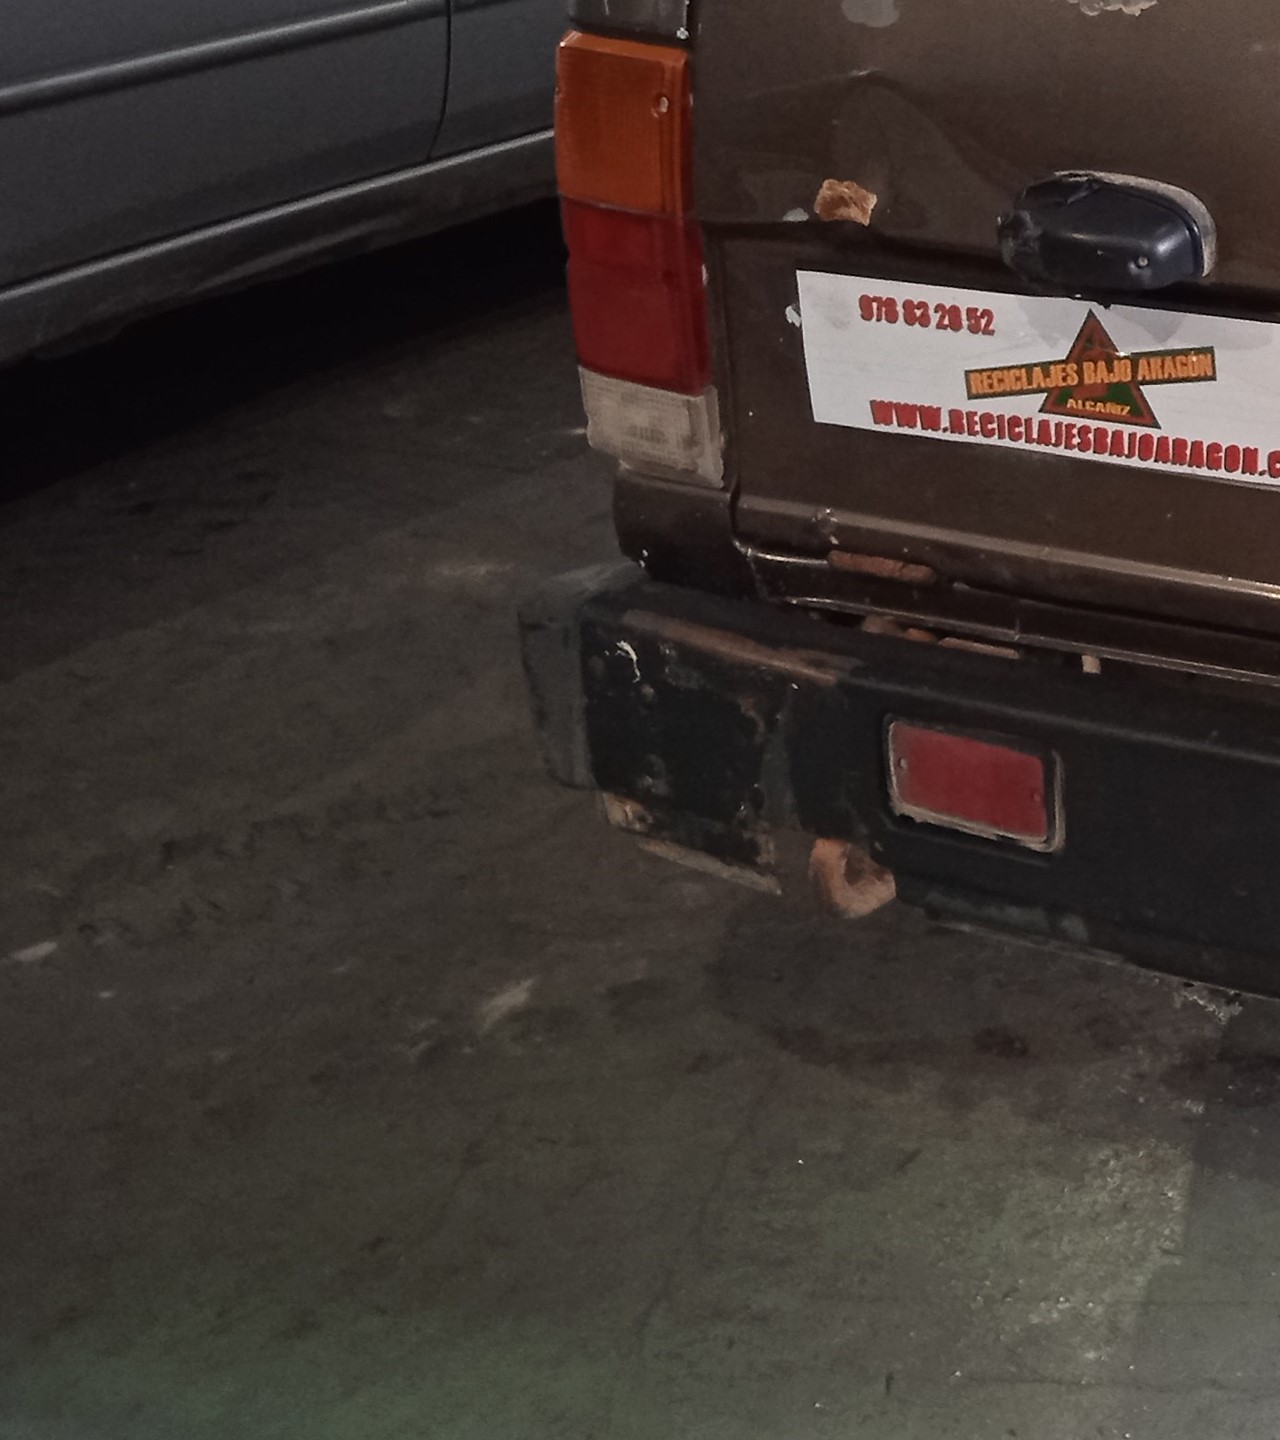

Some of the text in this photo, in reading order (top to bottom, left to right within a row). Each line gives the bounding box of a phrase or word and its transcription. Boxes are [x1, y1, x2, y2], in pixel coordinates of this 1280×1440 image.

[858, 294, 899, 324] 978
[966, 306, 995, 336] 52
[969, 351, 1213, 394] RECICLAJES BAJO ARAGÓN
